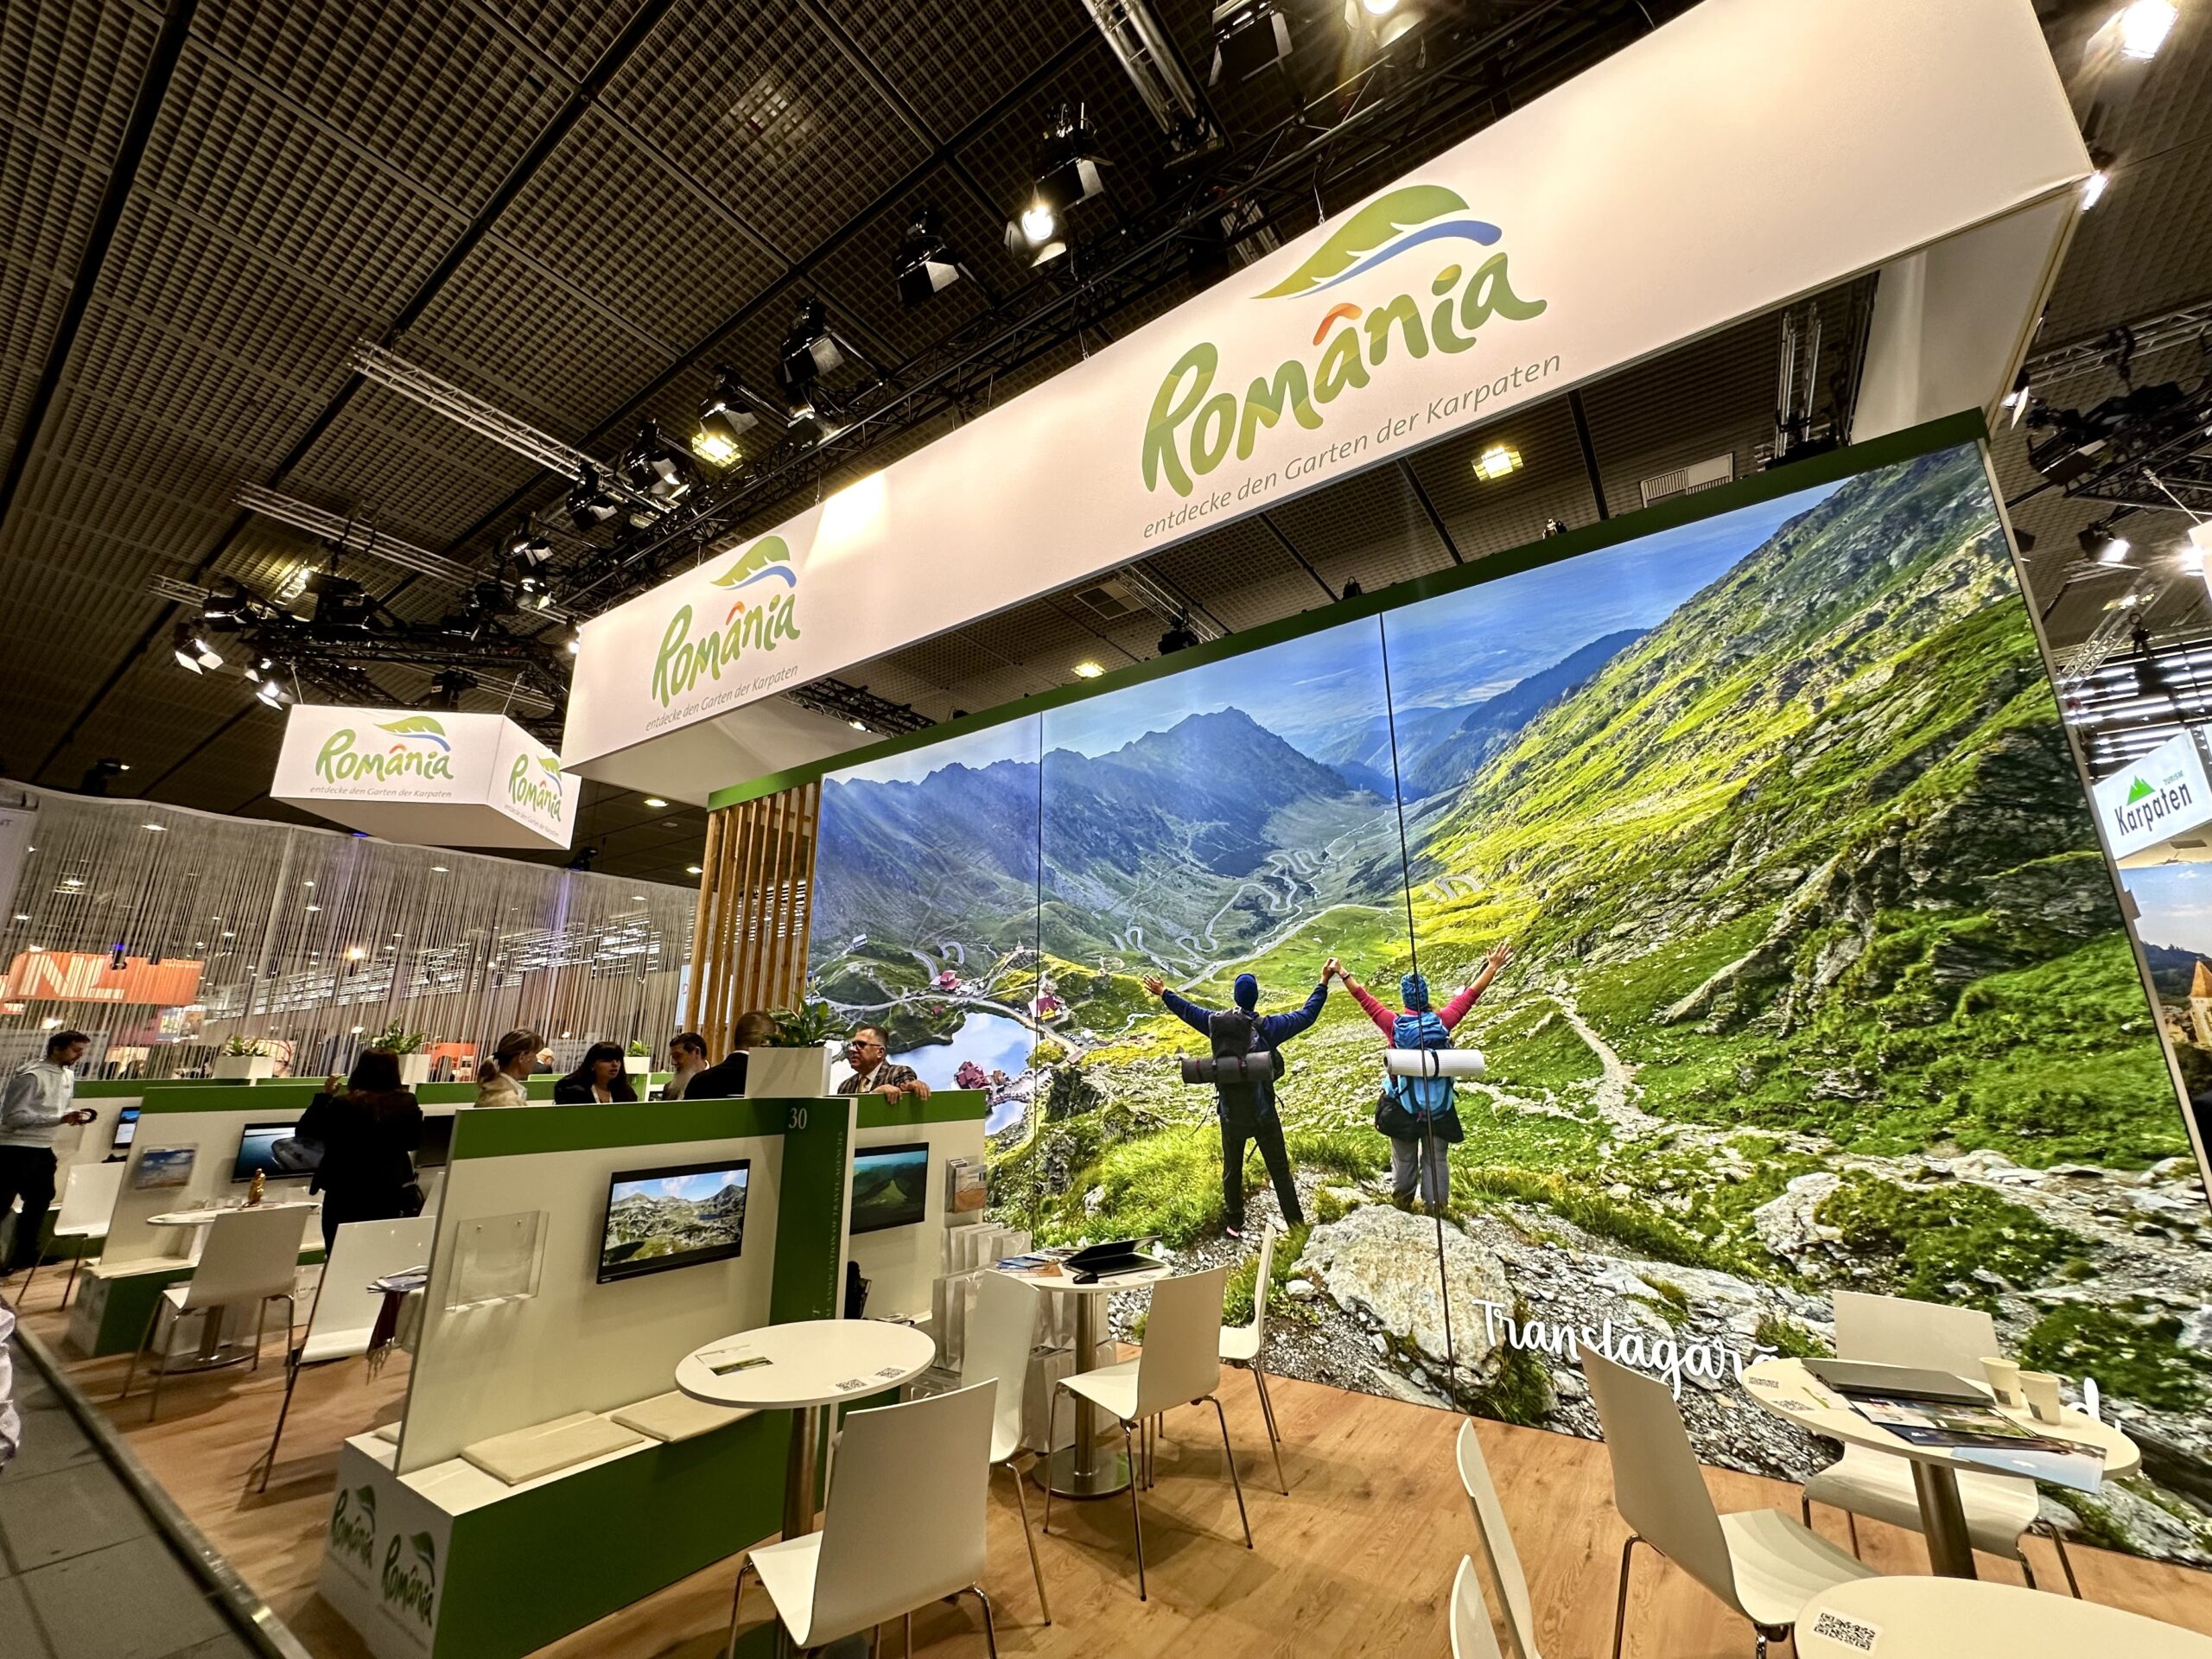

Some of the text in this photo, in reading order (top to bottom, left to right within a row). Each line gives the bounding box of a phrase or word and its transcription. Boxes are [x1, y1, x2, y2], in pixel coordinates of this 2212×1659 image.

[1142, 252, 1547, 497] România
[1143, 355, 1560, 538] entdecke den Garten der Karpaten
[652, 594, 800, 708] România
[645, 665, 798, 731] entdecke den Garten der Karpaten
[315, 728, 454, 784] România
[310, 785, 348, 795] entdecke
[367, 787, 397, 797] Garten
[398, 788, 413, 797] der
[413, 790, 452, 799] Karpaten
[508, 753, 561, 822] România
[2114, 783, 2192, 836] Karpaten
[18, 953, 124, 1000] NL
[789, 1107, 808, 1129] 30
[832, 1181, 841, 1217] TRAVEL
